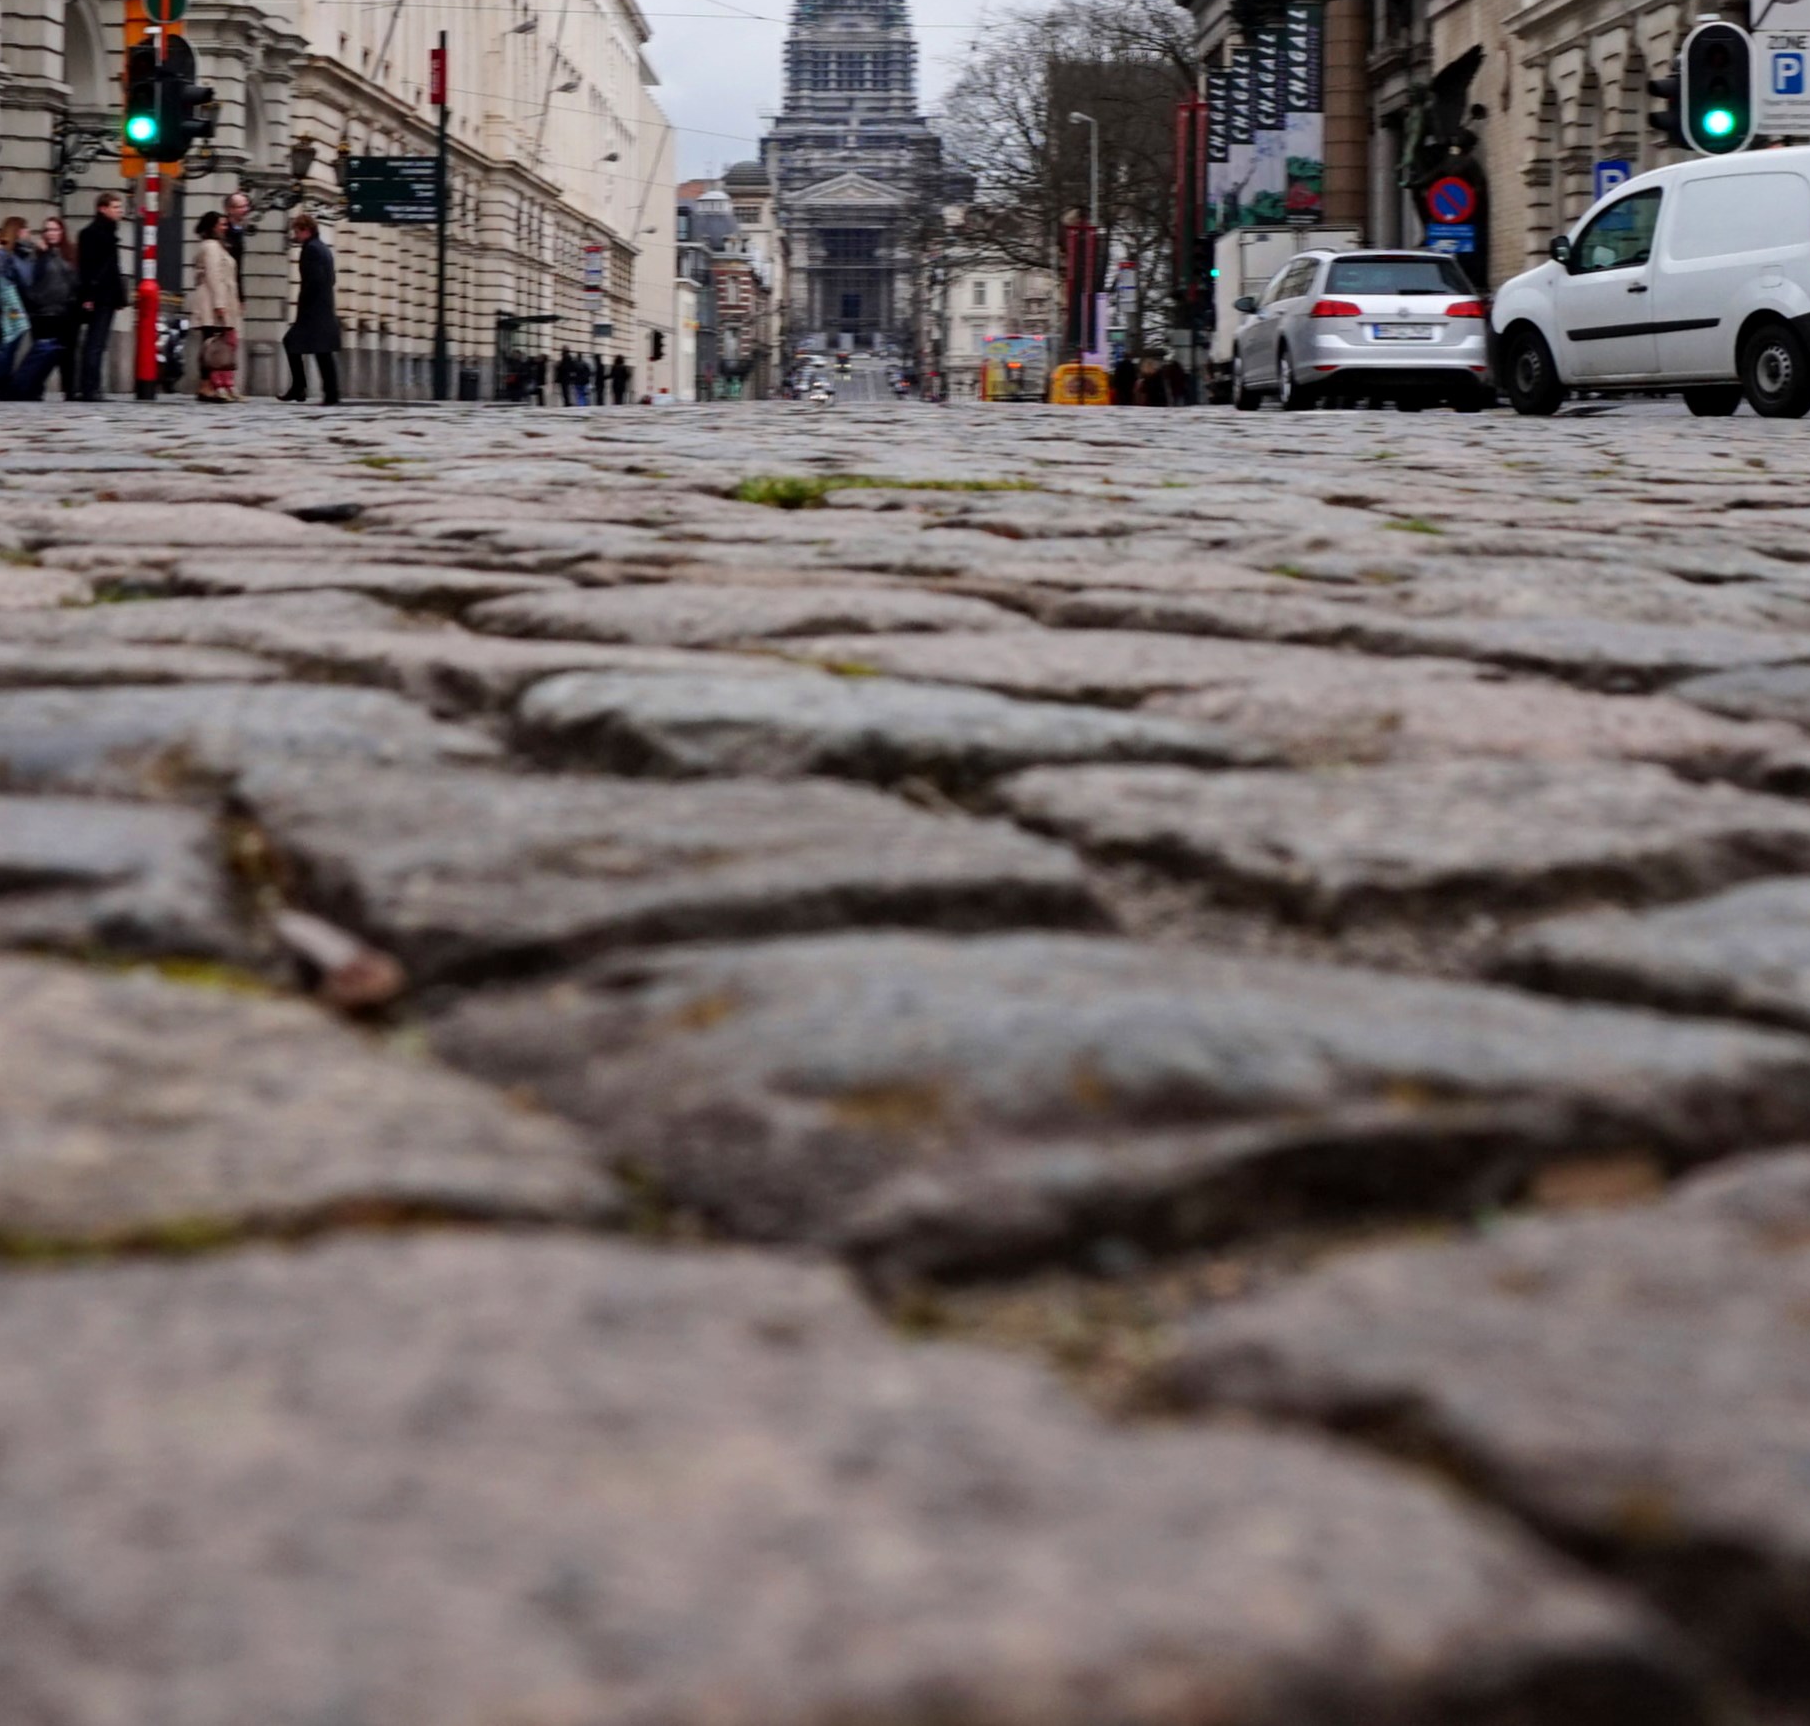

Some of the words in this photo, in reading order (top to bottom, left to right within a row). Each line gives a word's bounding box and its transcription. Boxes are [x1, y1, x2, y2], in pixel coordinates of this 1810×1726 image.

[1258, 33, 1277, 125] CHAGALL
[1287, 9, 1308, 107] CHAGALL
[1767, 35, 1810, 50] ZONE
[1775, 58, 1800, 91] P
[1209, 77, 1227, 158] CHAGALL
[1232, 54, 1250, 140] CHAGALL
